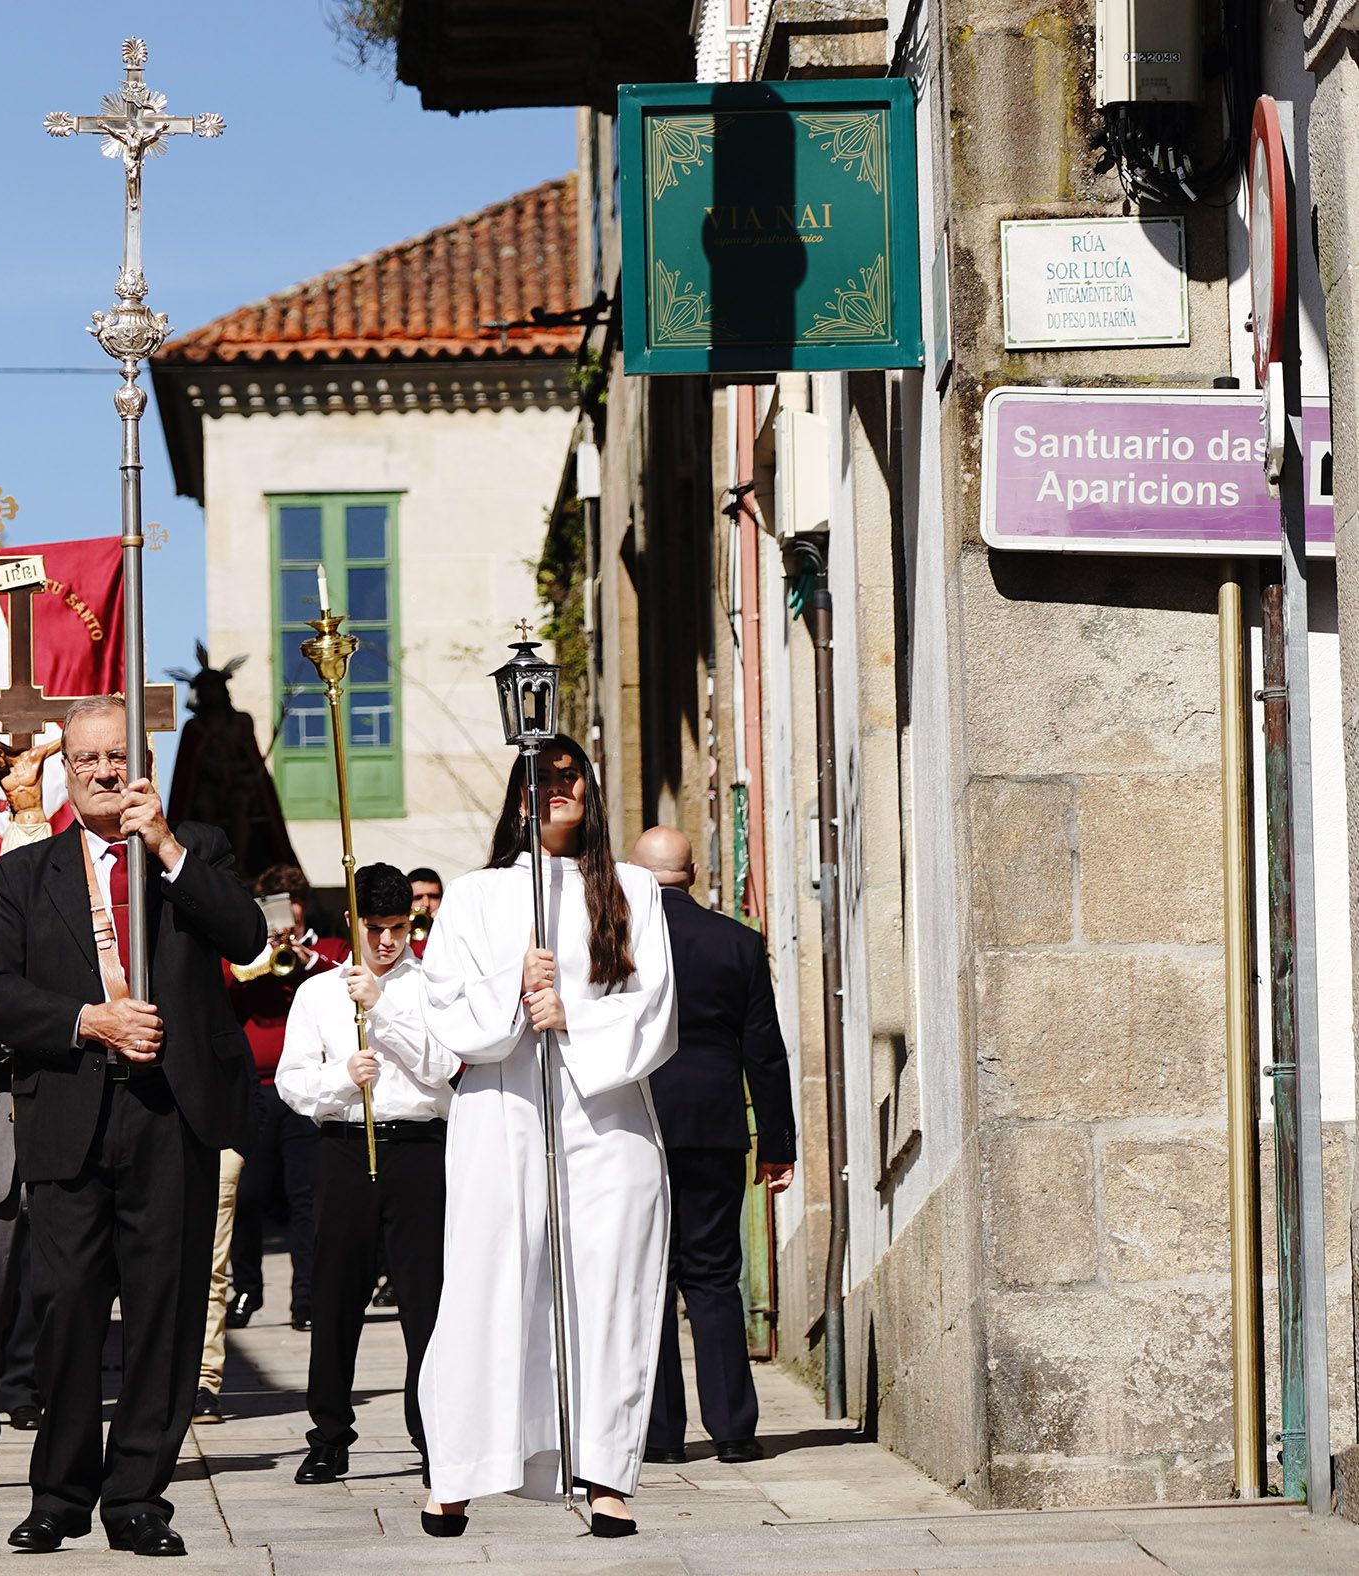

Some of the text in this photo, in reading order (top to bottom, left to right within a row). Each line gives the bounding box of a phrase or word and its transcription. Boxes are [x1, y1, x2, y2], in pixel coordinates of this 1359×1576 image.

[704, 203, 834, 230] VIA NAI
[1072, 230, 1106, 252] RÚA
[1046, 256, 1132, 280] SOR LUCÍA
[1046, 283, 1133, 304] ANTIGAMENTE RÚA
[1047, 308, 1137, 329] DO PESO DA FARIÑA
[1013, 425, 1267, 461] Santuario das
[1036, 470, 1240, 511] Aparicions
[65, 593, 104, 641] SANTO
